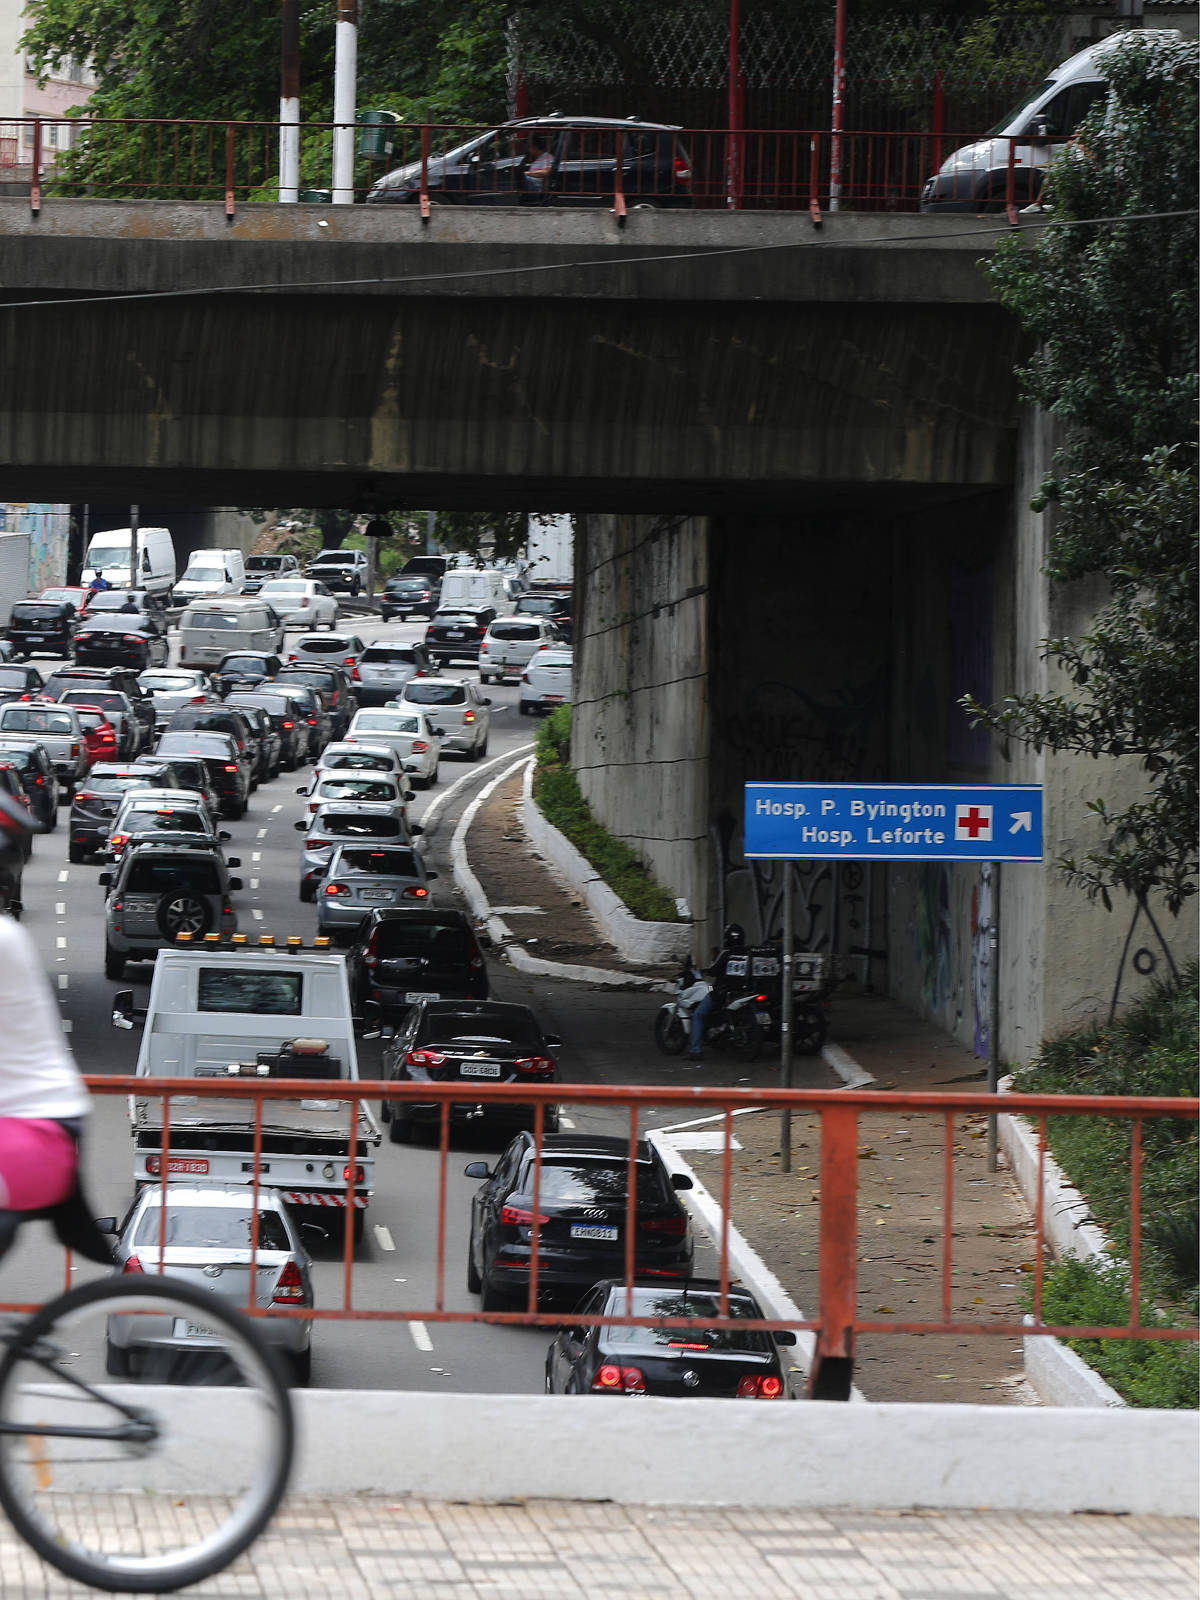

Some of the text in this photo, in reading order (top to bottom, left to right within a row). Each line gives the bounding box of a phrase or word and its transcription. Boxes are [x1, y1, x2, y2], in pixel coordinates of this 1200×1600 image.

[756, 799, 946, 824] Hosp. P. Byington
[802, 826, 945, 846] Hosp. Leforte
